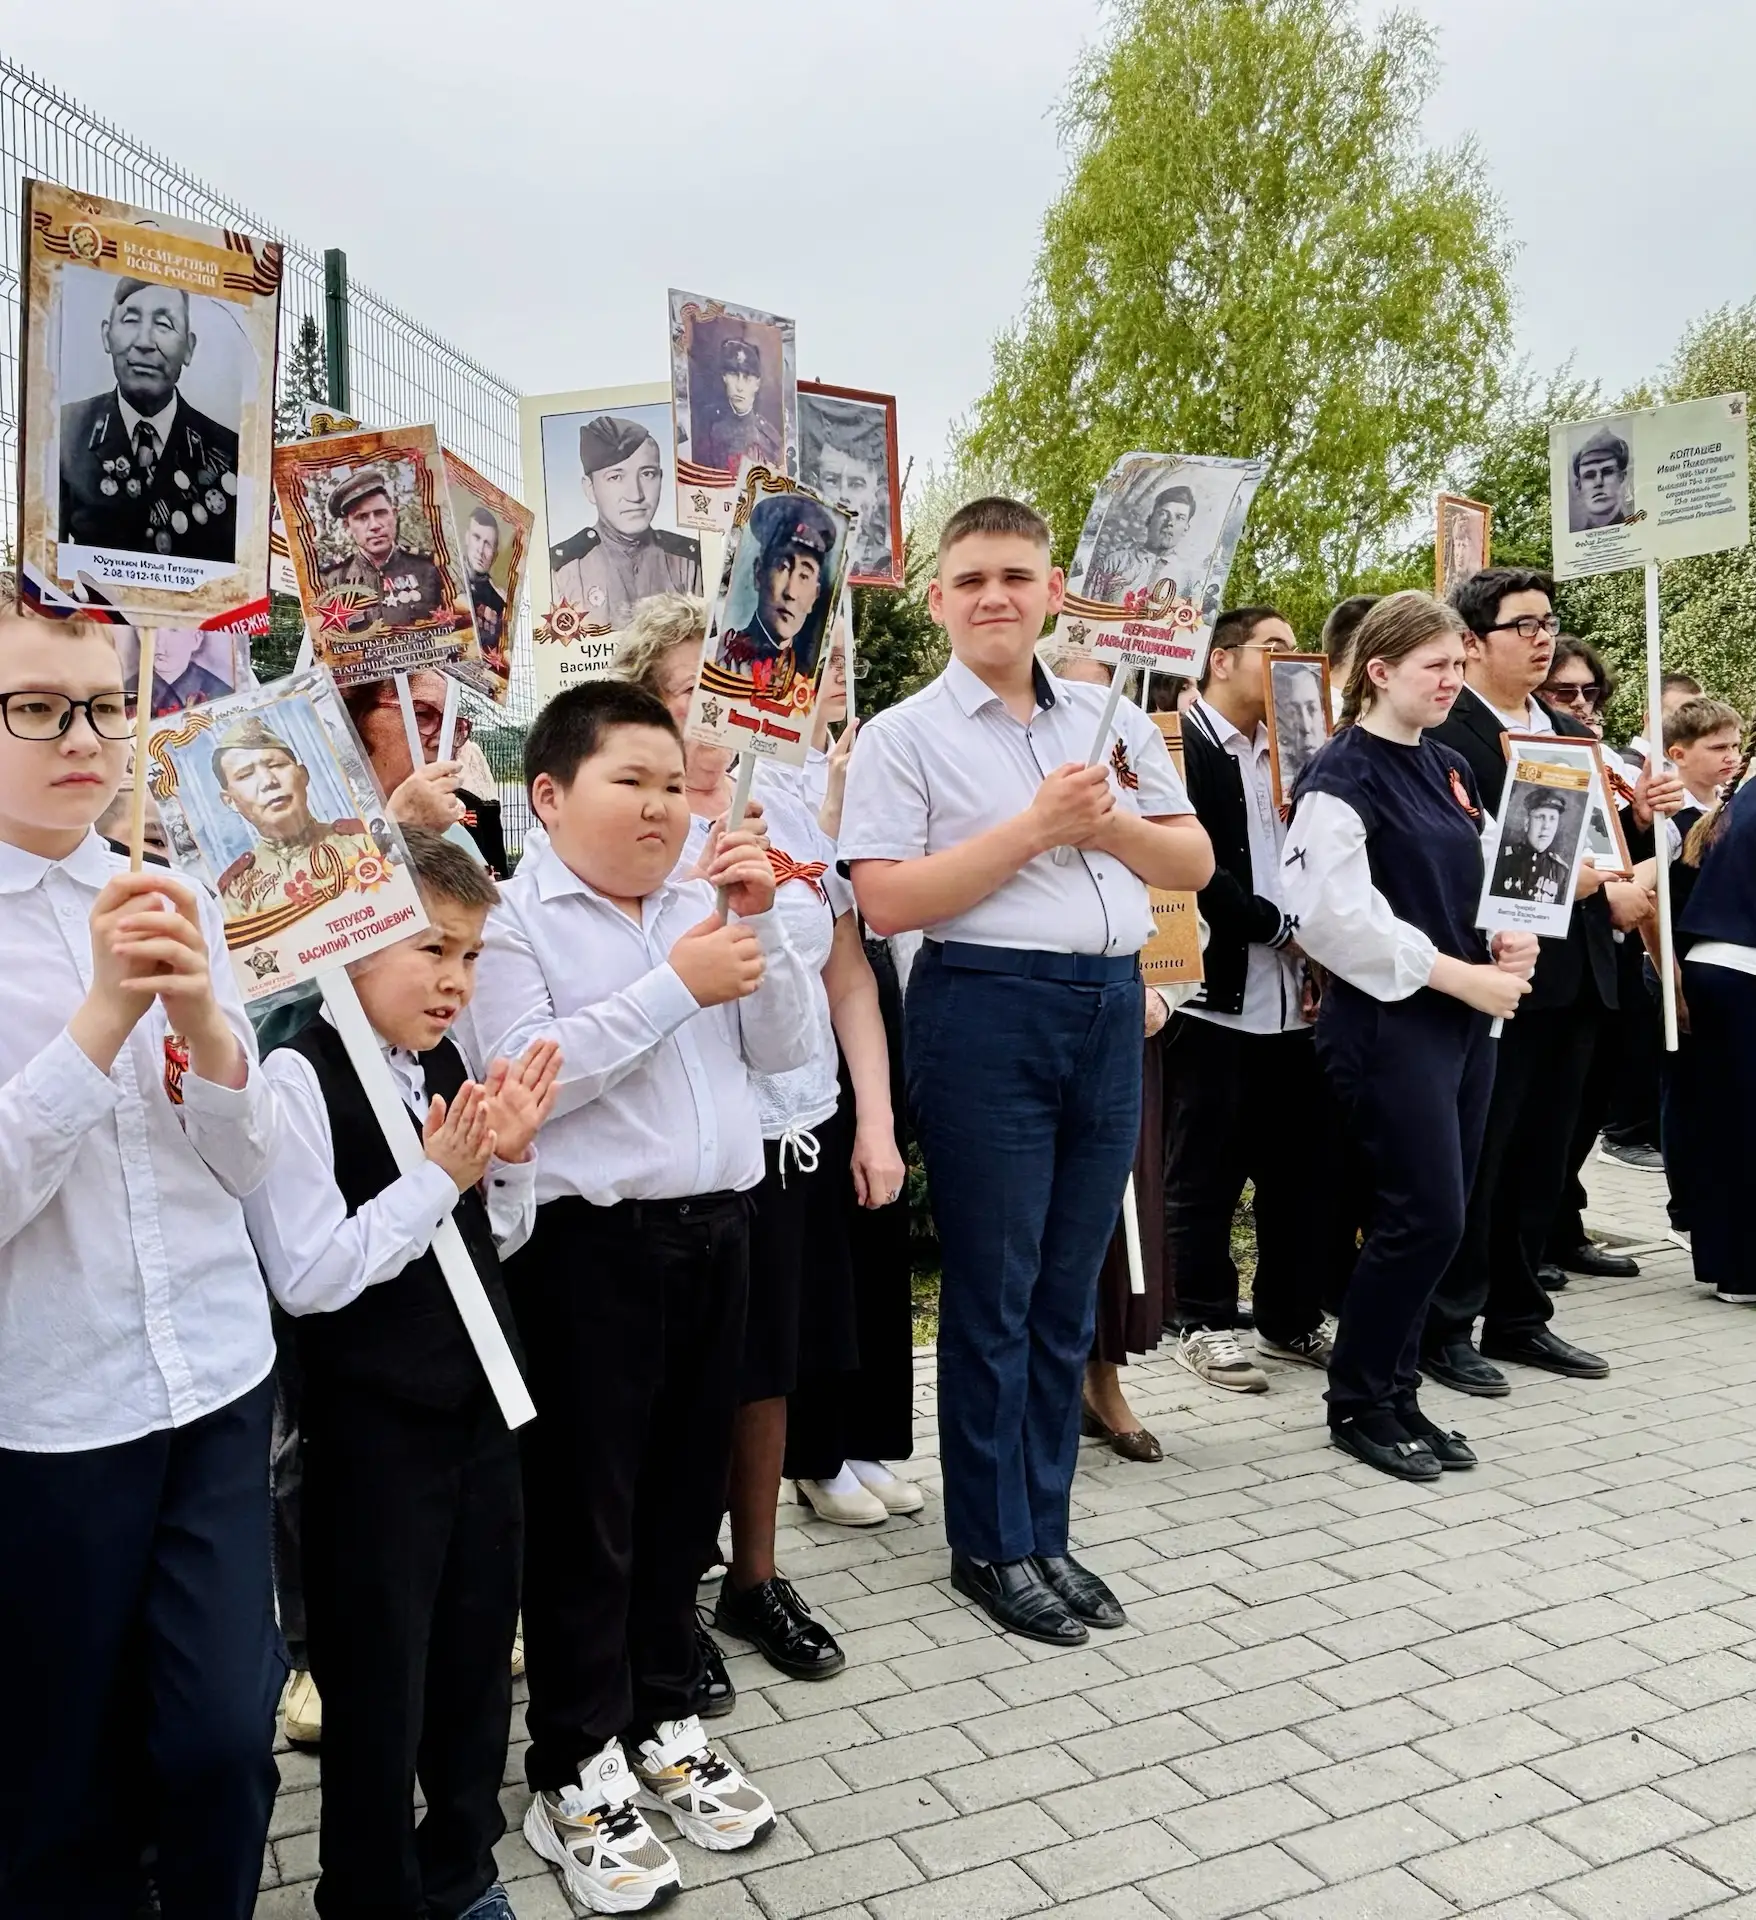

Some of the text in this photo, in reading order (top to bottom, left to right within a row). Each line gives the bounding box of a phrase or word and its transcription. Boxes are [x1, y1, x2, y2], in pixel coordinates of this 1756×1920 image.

[127, 256, 216, 288] ПОЛК РОССИИ
[217, 612, 270, 635] АДЕЖН
[580, 643, 618, 658] ЧУН
[1120, 652, 1158, 667] РЯДОВОЙ
[560, 661, 610, 673] Васили
[298, 905, 416, 964] ВАСИЛИЙ ТОТОШЕВИЧ
